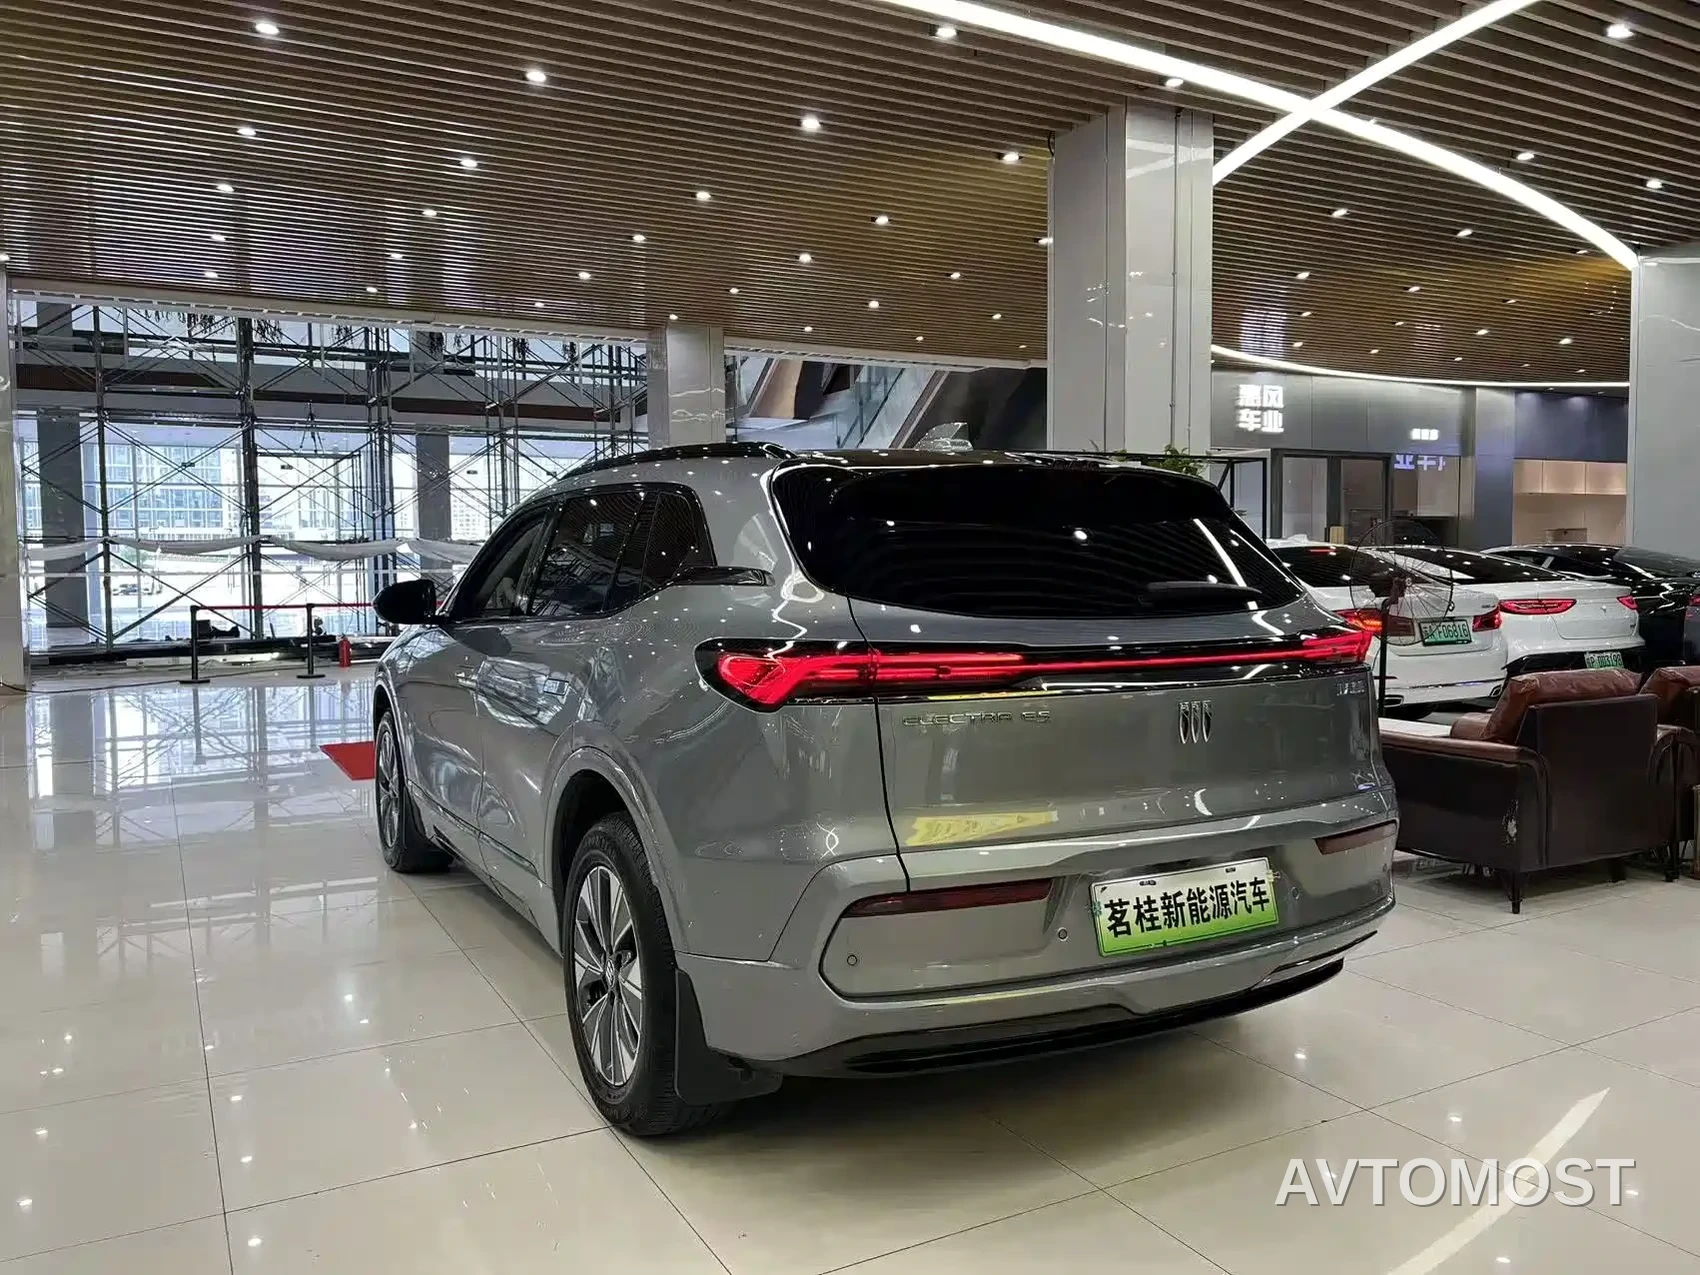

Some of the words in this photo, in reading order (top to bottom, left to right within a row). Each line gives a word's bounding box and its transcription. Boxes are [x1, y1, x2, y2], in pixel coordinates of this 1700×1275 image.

[902, 711, 1012, 726] ELECTRA
[1021, 710, 1051, 724] E5
[1104, 877, 1270, 938] 茗桂新能源汽车
